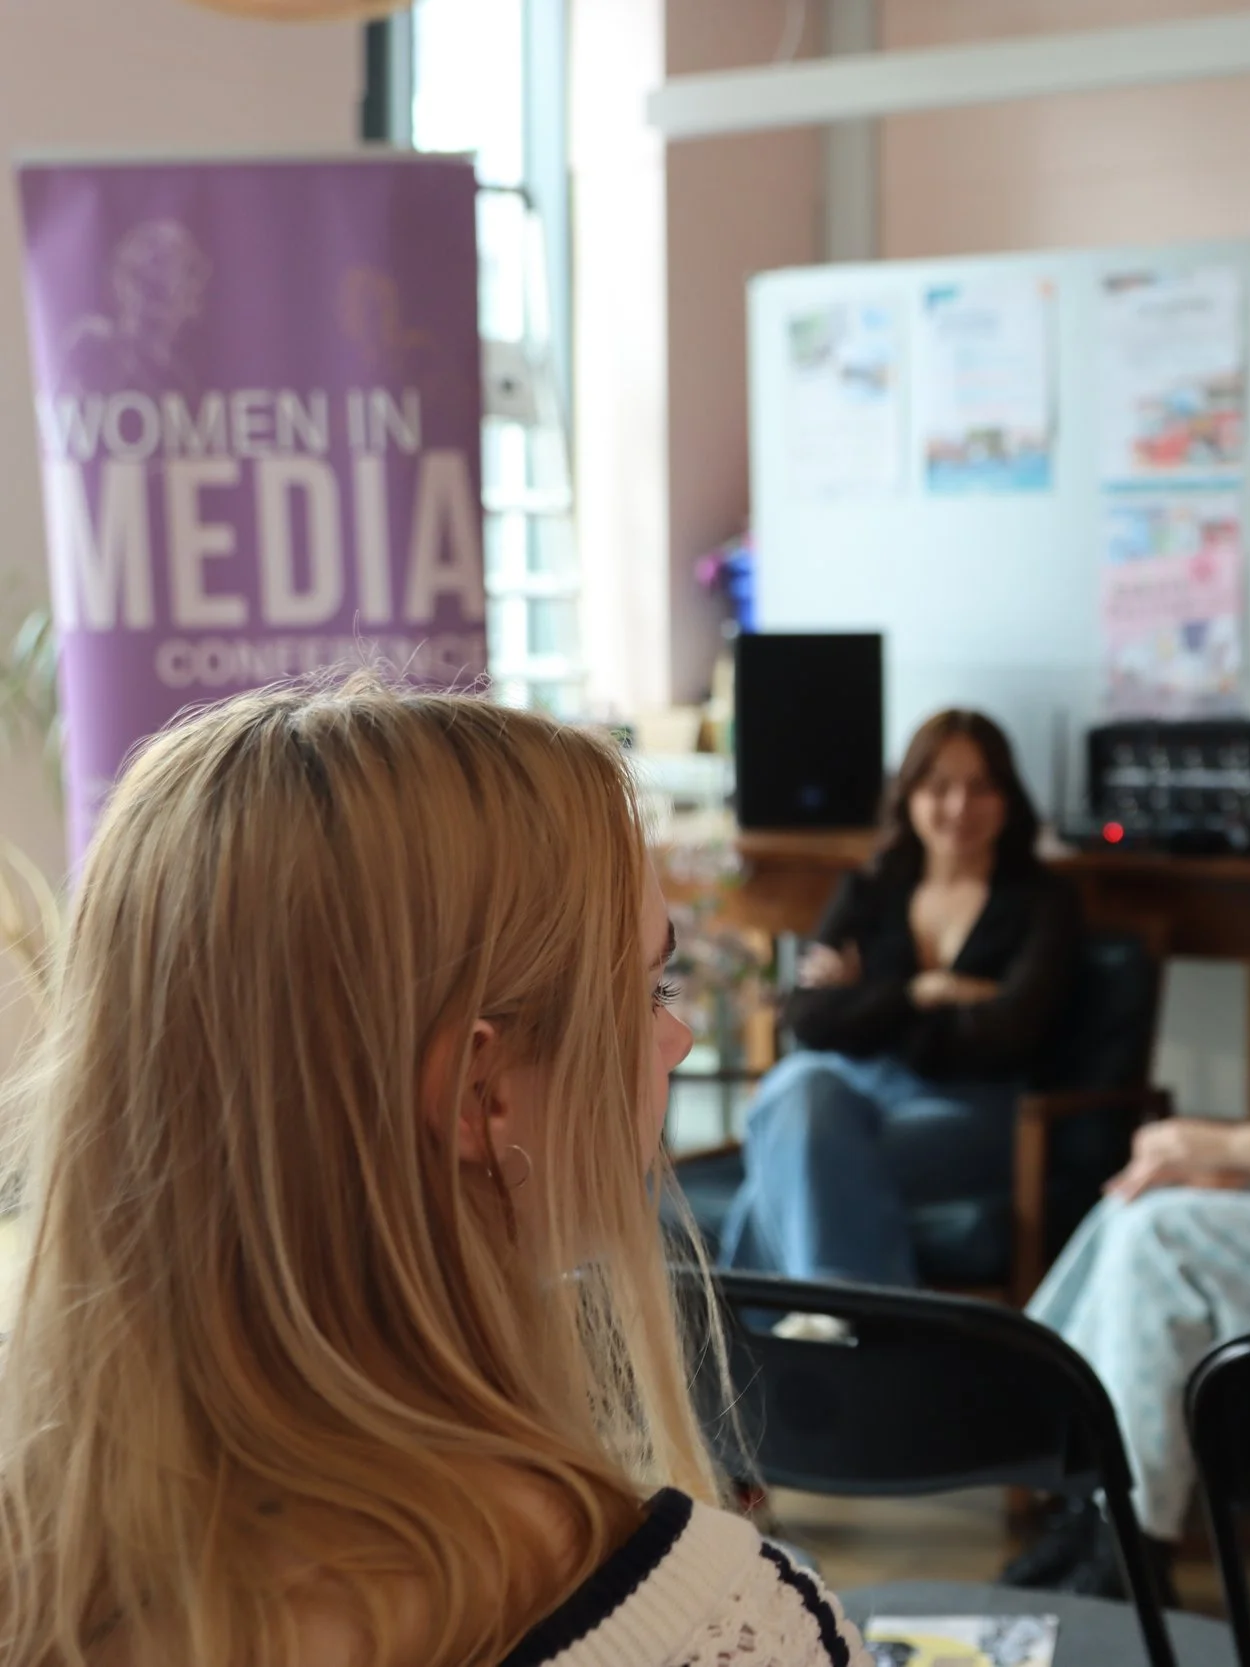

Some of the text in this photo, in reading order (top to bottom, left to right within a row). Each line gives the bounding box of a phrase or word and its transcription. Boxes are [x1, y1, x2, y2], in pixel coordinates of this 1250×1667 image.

[44, 387, 422, 463] WOMEN IN
[50, 451, 485, 630] MEDIA
